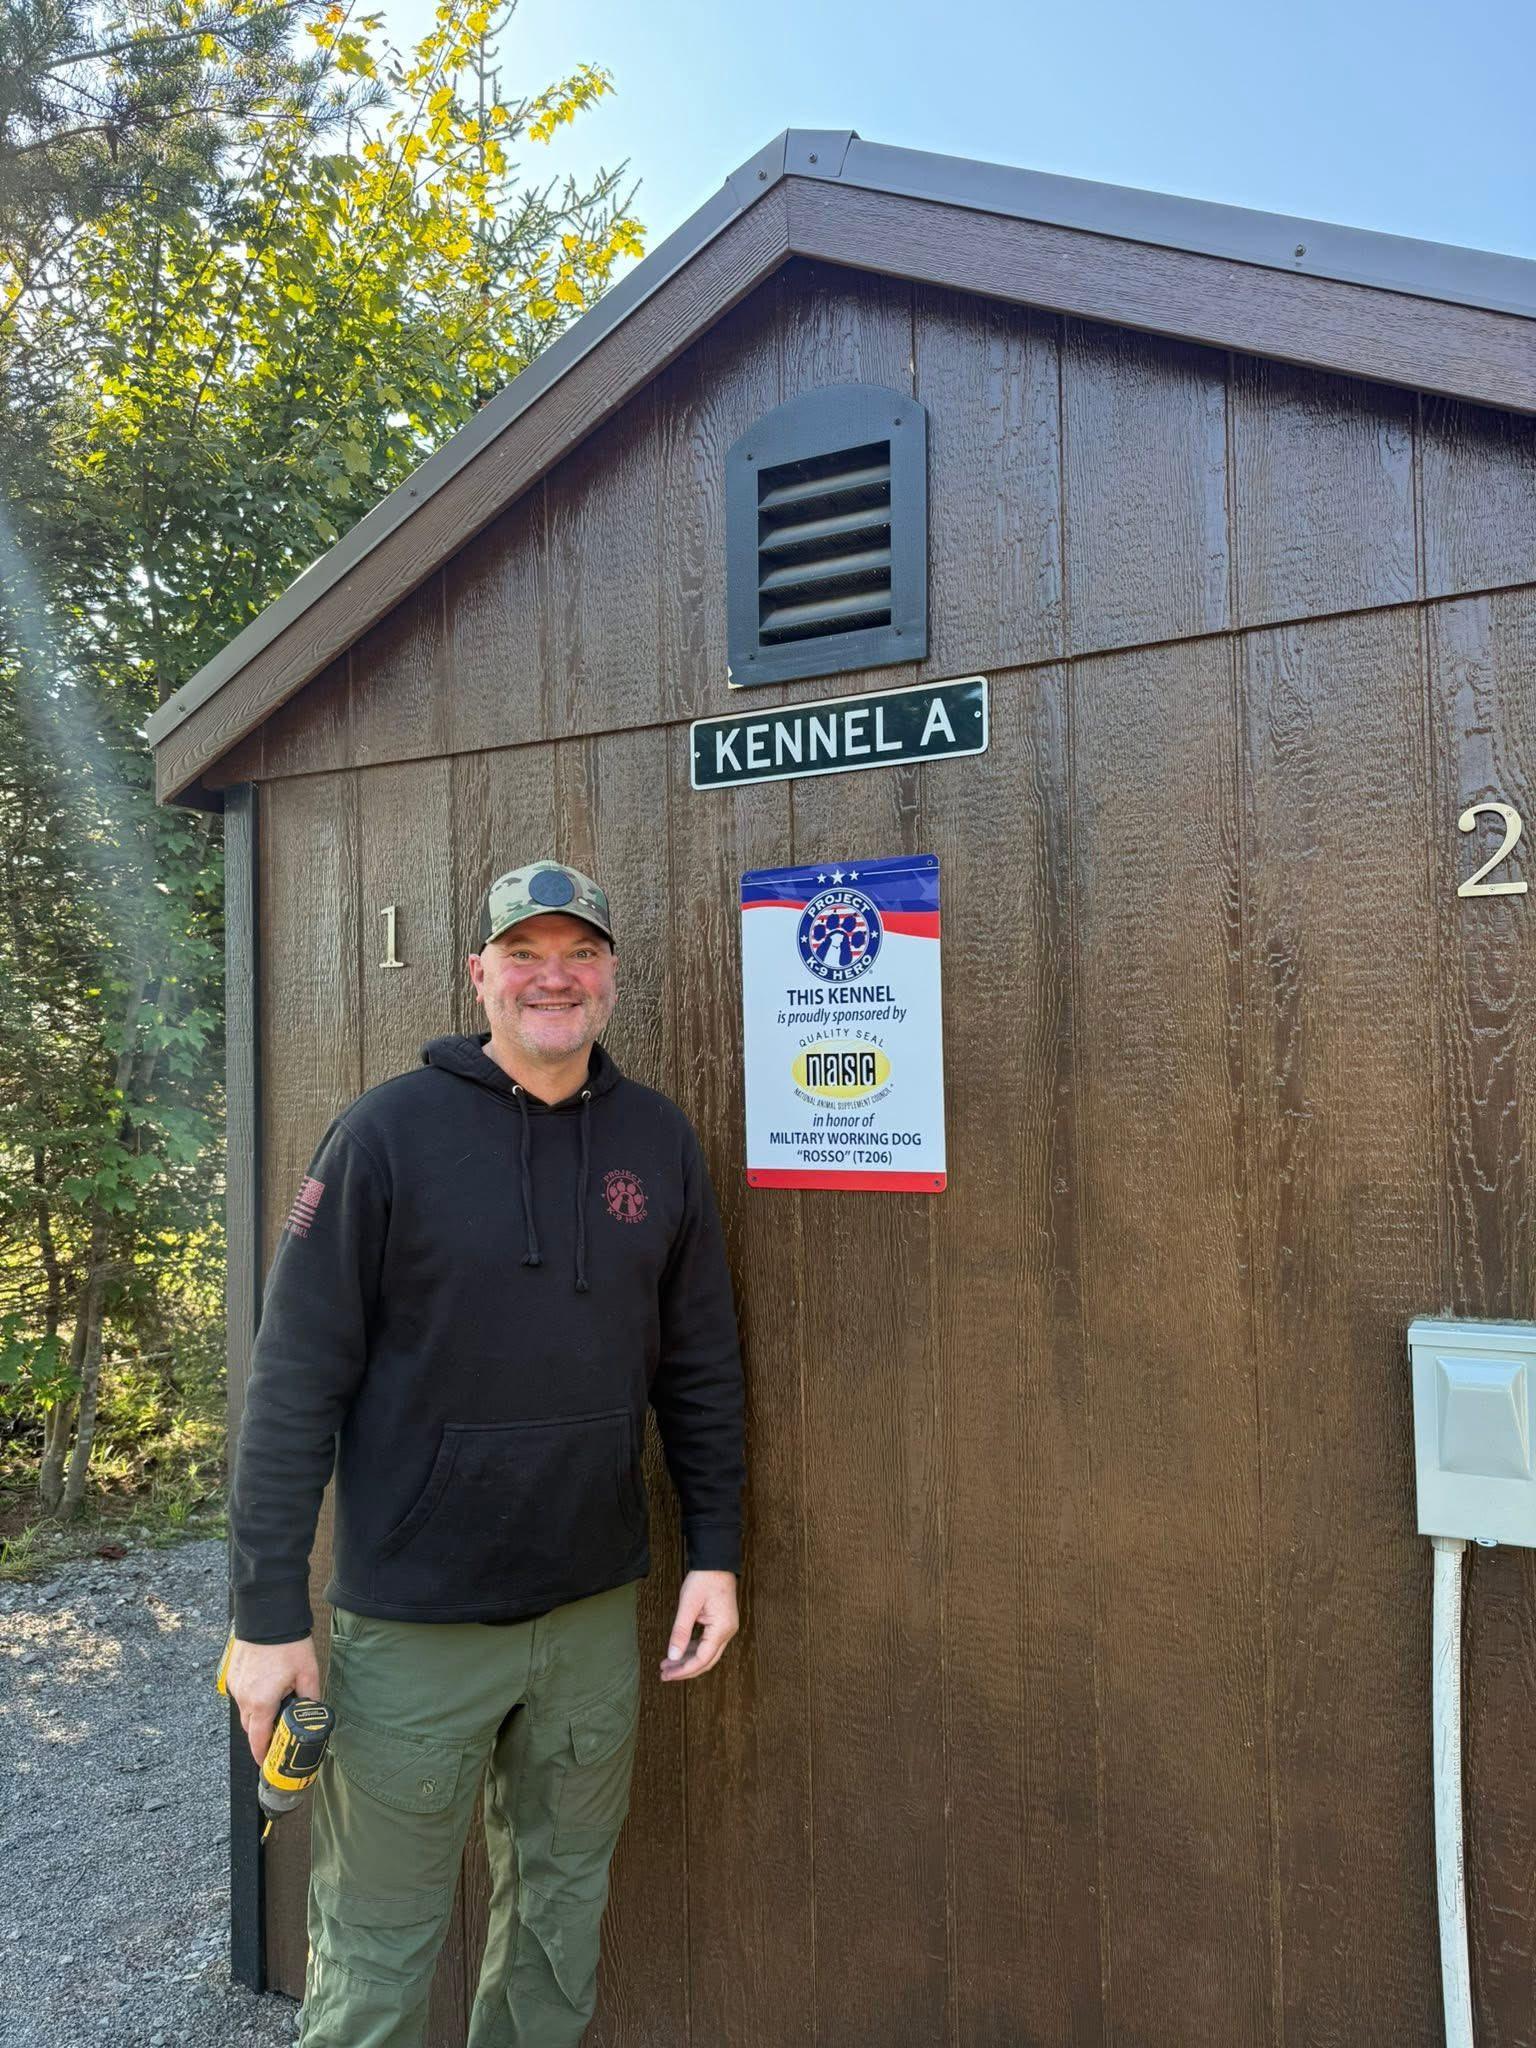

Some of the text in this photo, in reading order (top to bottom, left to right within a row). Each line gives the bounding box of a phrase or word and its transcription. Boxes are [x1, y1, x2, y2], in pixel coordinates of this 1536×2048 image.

[715, 697, 956, 774] KENNEL A
[1457, 802, 1528, 897] 2
[807, 892, 871, 918] PROJECT
[378, 905, 404, 969] 1
[806, 954, 873, 980] K-9 HERO
[786, 985, 896, 1006] THIS KENNEL
[776, 1005, 907, 1026] is proudly sponsored by
[798, 1028, 885, 1048] QUALITY SEAL
[806, 1053, 876, 1086] nasc
[793, 1087, 816, 1106] NATIONAL
[816, 1099, 836, 1111] ANIMAL
[812, 1112, 876, 1128] in honor of
[769, 1132, 922, 1146] MILITARY WORKING DOG
[852, 1150, 893, 1166] (T206)
[603, 1169, 643, 1184] PROJECT
